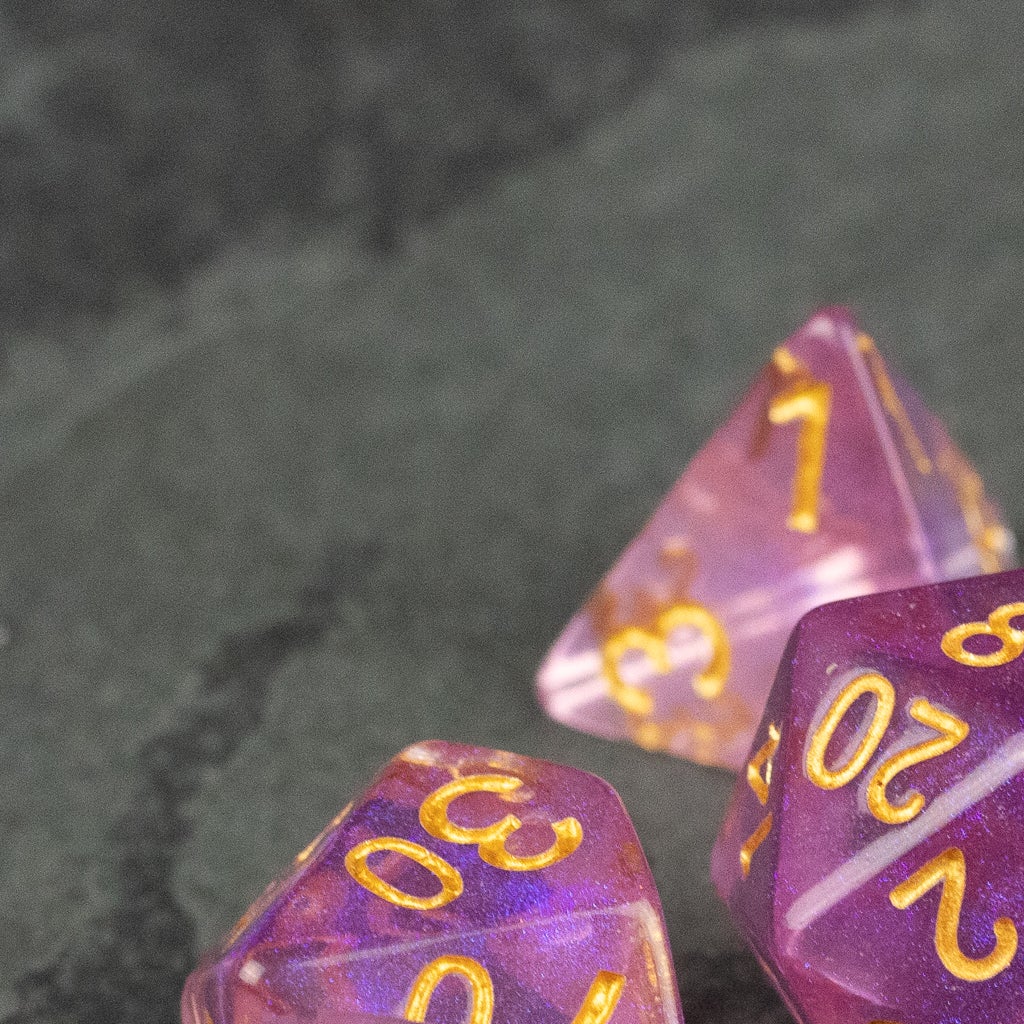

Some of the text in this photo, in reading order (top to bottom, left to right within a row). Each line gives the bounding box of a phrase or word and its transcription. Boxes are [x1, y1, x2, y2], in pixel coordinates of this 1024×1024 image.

[768, 382, 833, 533] 1
[601, 604, 731, 716] 3
[804, 672, 970, 825] 20
[345, 774, 584, 911] 30
[889, 847, 1019, 983] 2
